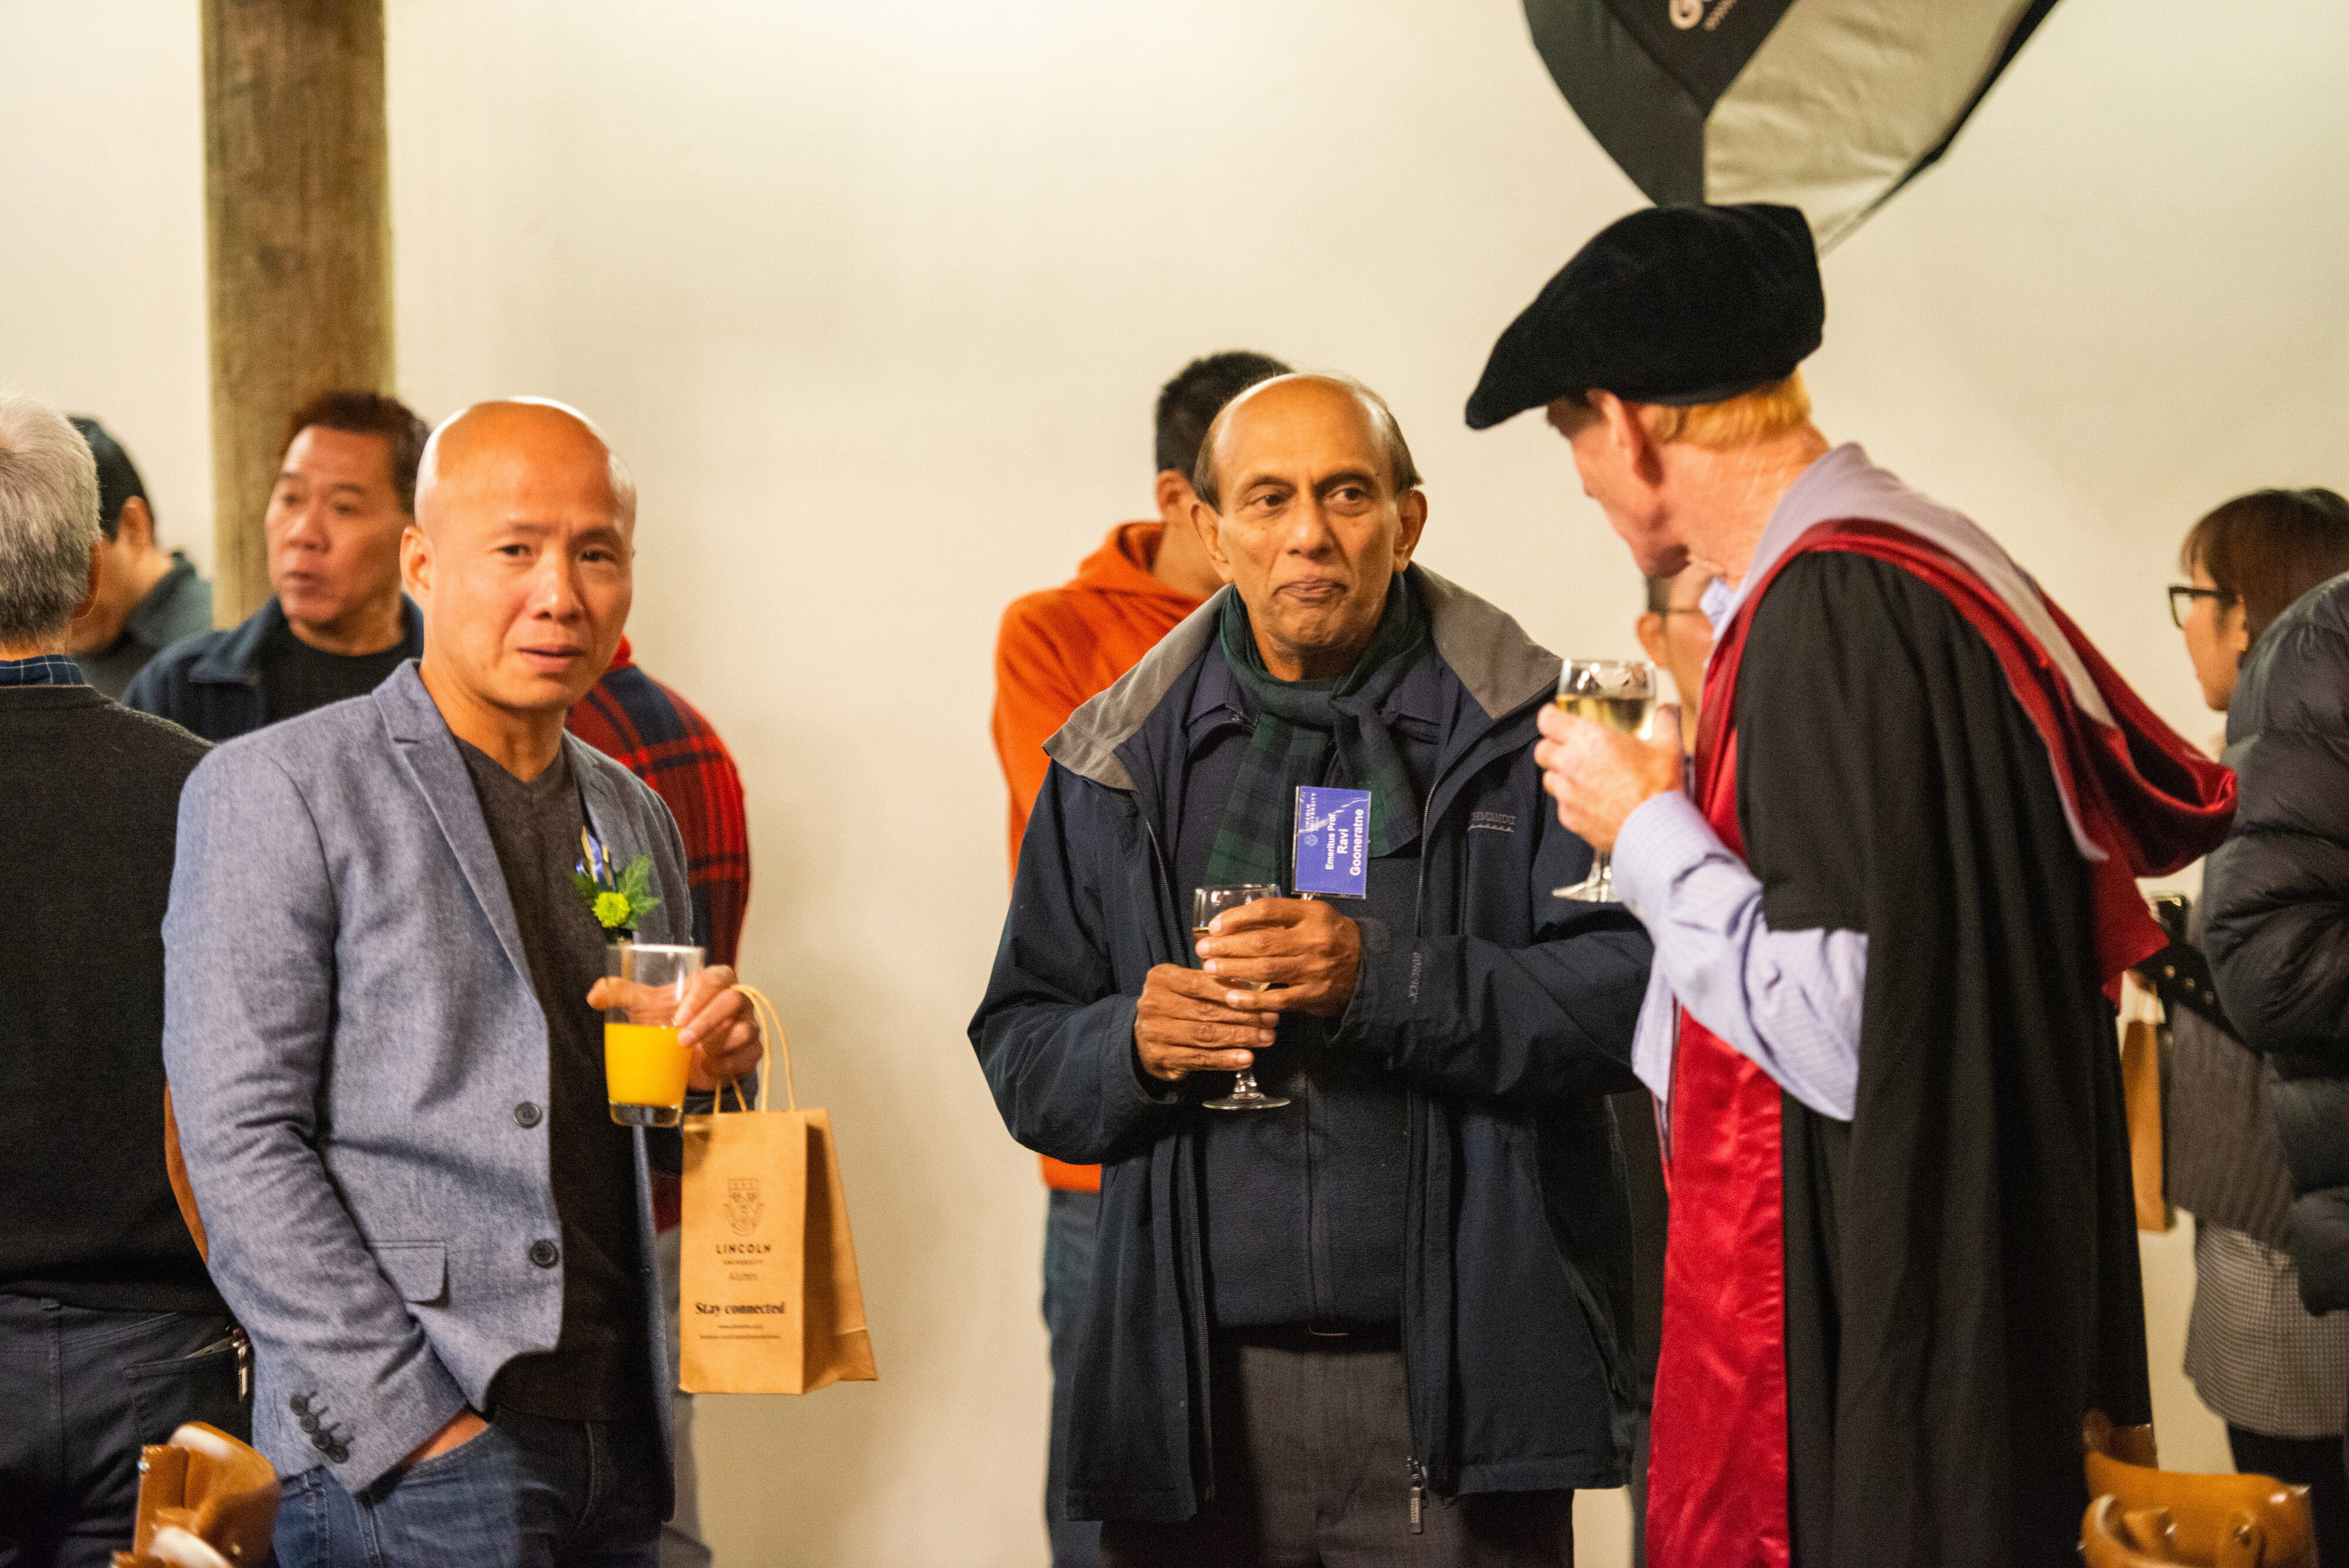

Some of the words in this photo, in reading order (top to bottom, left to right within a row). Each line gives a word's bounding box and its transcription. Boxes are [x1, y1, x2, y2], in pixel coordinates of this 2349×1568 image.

[1325, 833, 1335, 870] Emeritus
[1337, 829, 1349, 854] Ravi
[1350, 809, 1364, 876] Gooneratne
[716, 1243, 771, 1254] LINCOLN
[695, 1301, 720, 1317] Stay
[725, 1301, 785, 1314] connected
